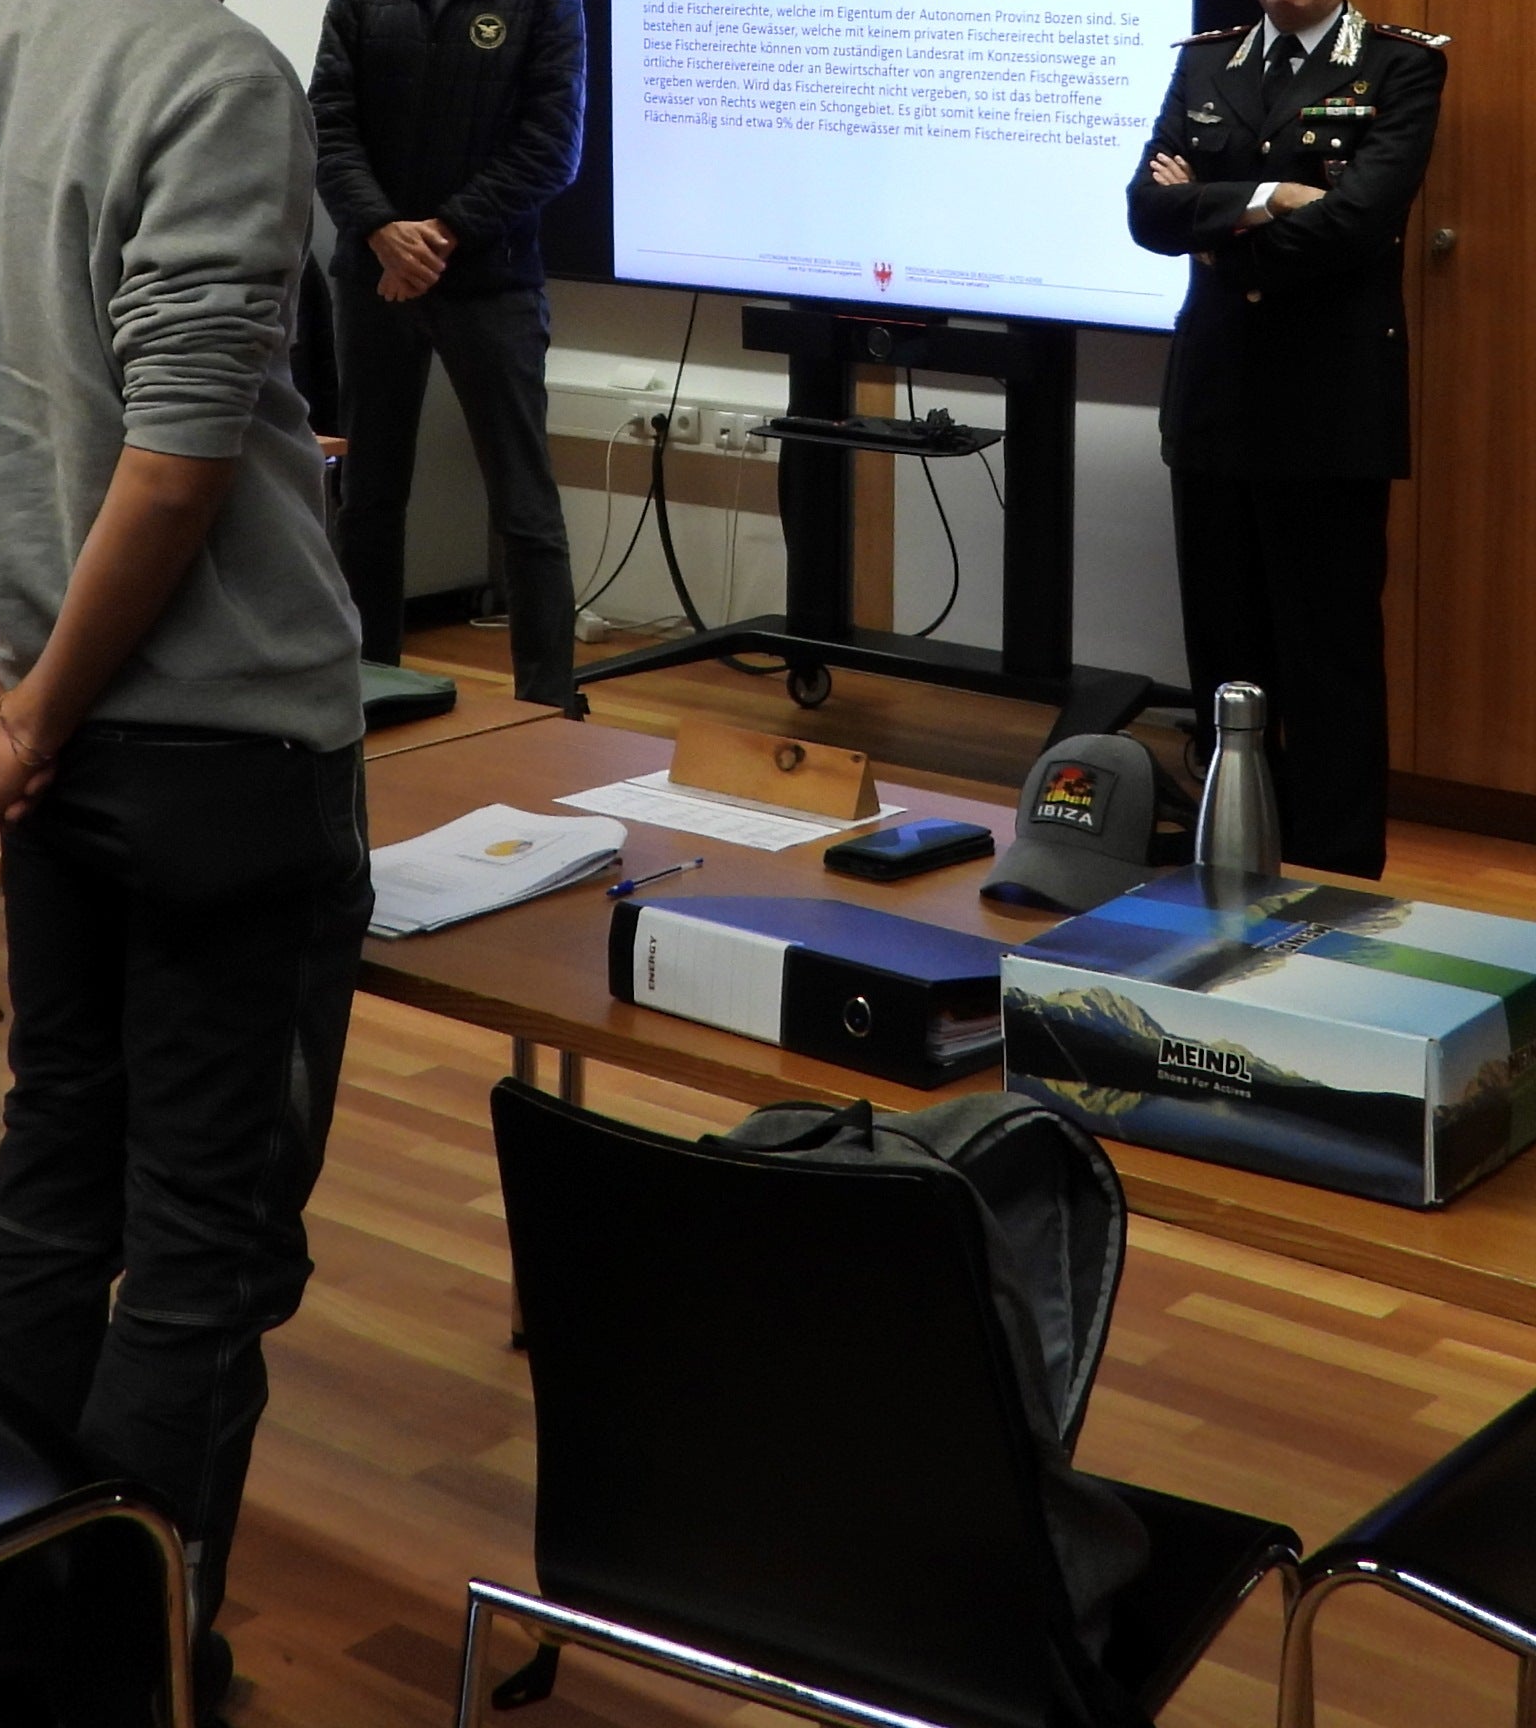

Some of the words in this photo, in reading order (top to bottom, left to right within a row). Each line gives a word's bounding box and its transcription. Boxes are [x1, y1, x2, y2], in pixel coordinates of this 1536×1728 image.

[642, 0, 665, 13] sind
[667, 0, 684, 14] die
[687, 1, 773, 18] Fischereirechte,
[776, 3, 816, 17] welche
[819, 4, 834, 18] im
[837, 4, 893, 21] Eigentum
[895, 6, 915, 20] der
[919, 6, 991, 22] Autonomen
[995, 8, 1040, 23] Provinz
[1044, 10, 1082, 24] Bozen
[1086, 11, 1116, 25] sind.
[1120, 12, 1140, 25] Sie
[643, 18, 692, 33] bestehen
[695, 20, 713, 33] auf
[715, 20, 739, 36] jene
[742, 21, 798, 37] Gewässer,
[801, 23, 842, 37] welche
[845, 24, 864, 37] mit
[867, 24, 911, 38] keinem
[914, 26, 963, 42] privaten
[967, 27, 1054, 42] Fischereirecht
[1058, 29, 1109, 44] belastet
[1113, 31, 1144, 45] sind.
[643, 37, 672, 51] Diese
[675, 38, 757, 54] Fischereirechte
[760, 40, 802, 55] können
[804, 45, 830, 56] vom
[832, 44, 903, 61] zuständigen
[906, 45, 964, 60] Landesrat
[968, 47, 983, 61] im
[987, 47, 1096, 67] Konzessionswege
[1100, 54, 1116, 65] an
[643, 55, 684, 69] örtliche
[686, 56, 775, 72] Fischereivereine
[777, 59, 804, 73] oder
[807, 64, 822, 74] an
[825, 61, 909, 77] Bewirtschafter
[913, 68, 935, 78] von
[939, 68, 1025, 82] angrenzenden
[1030, 69, 1129, 86] Fischgewässern
[643, 74, 693, 90] vergeben
[695, 76, 740, 90] werden.
[743, 77, 770, 92] Wird
[772, 78, 792, 92] das
[795, 79, 875, 96] Fischereirecht
[878, 83, 907, 97] nicht
[911, 85, 970, 102] vergeben,
[974, 90, 988, 100] so
[992, 87, 1005, 101] ist
[1009, 88, 1031, 102] das
[1035, 89, 1102, 105] betroffene
[643, 92, 694, 107] Gewässer
[697, 98, 718, 108] von
[720, 95, 757, 110] Rechts
[759, 100, 796, 114] wegen
[799, 99, 817, 112] ein
[820, 99, 894, 117] Schongebiet.
[898, 103, 911, 116] Es
[914, 104, 936, 120] gibt
[940, 106, 974, 119] somit
[977, 106, 1010, 121] keine
[1014, 107, 1051, 122] freien
[1055, 109, 1149, 127] Fischgewässer.
[644, 110, 717, 130] Flächenmäßig
[720, 114, 743, 128] sind
[745, 117, 773, 129] etwa
[775, 116, 793, 130] 9%
[795, 117, 814, 131] der
[818, 118, 900, 136] Fischgewässer
[903, 123, 923, 137] mit
[927, 124, 971, 139] keinem
[974, 126, 1061, 143] Fischereirecht
[1065, 130, 1120, 146] belastet.
[1037, 804, 1093, 826] IBIZA
[648, 936, 658, 991] ENERGY
[1158, 1036, 1252, 1083] MEINDL
[1157, 1069, 1189, 1085] Shoes
[1192, 1077, 1210, 1089] For
[1213, 1082, 1252, 1099] Actives
